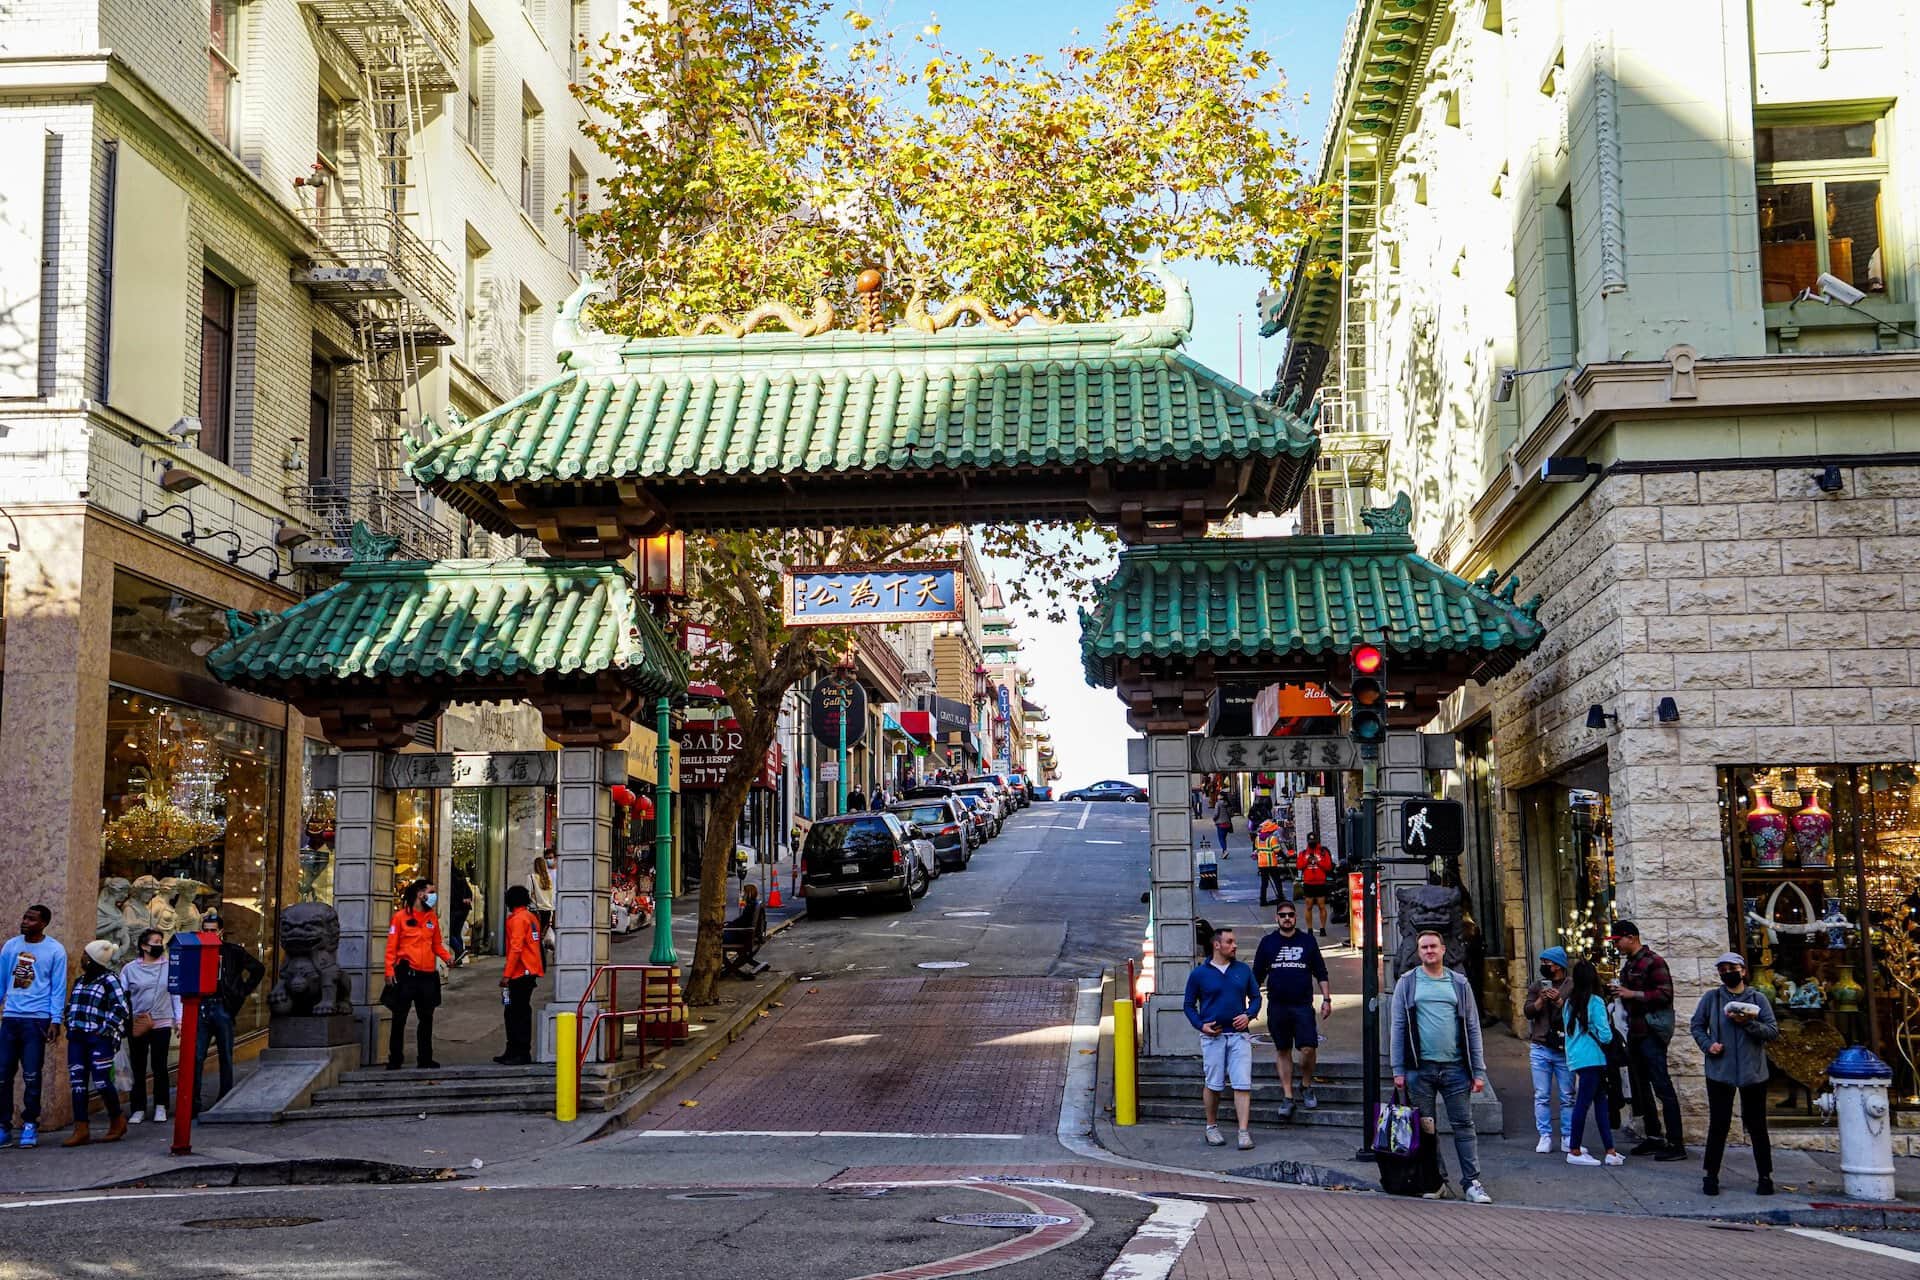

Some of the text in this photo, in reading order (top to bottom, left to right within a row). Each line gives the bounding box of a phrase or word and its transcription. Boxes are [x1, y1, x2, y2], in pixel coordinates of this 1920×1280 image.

[810, 576, 946, 608] 天下為公
[823, 697, 853, 709] Gally
[680, 731, 744, 751] SABR
[680, 756, 705, 765] GRILL
